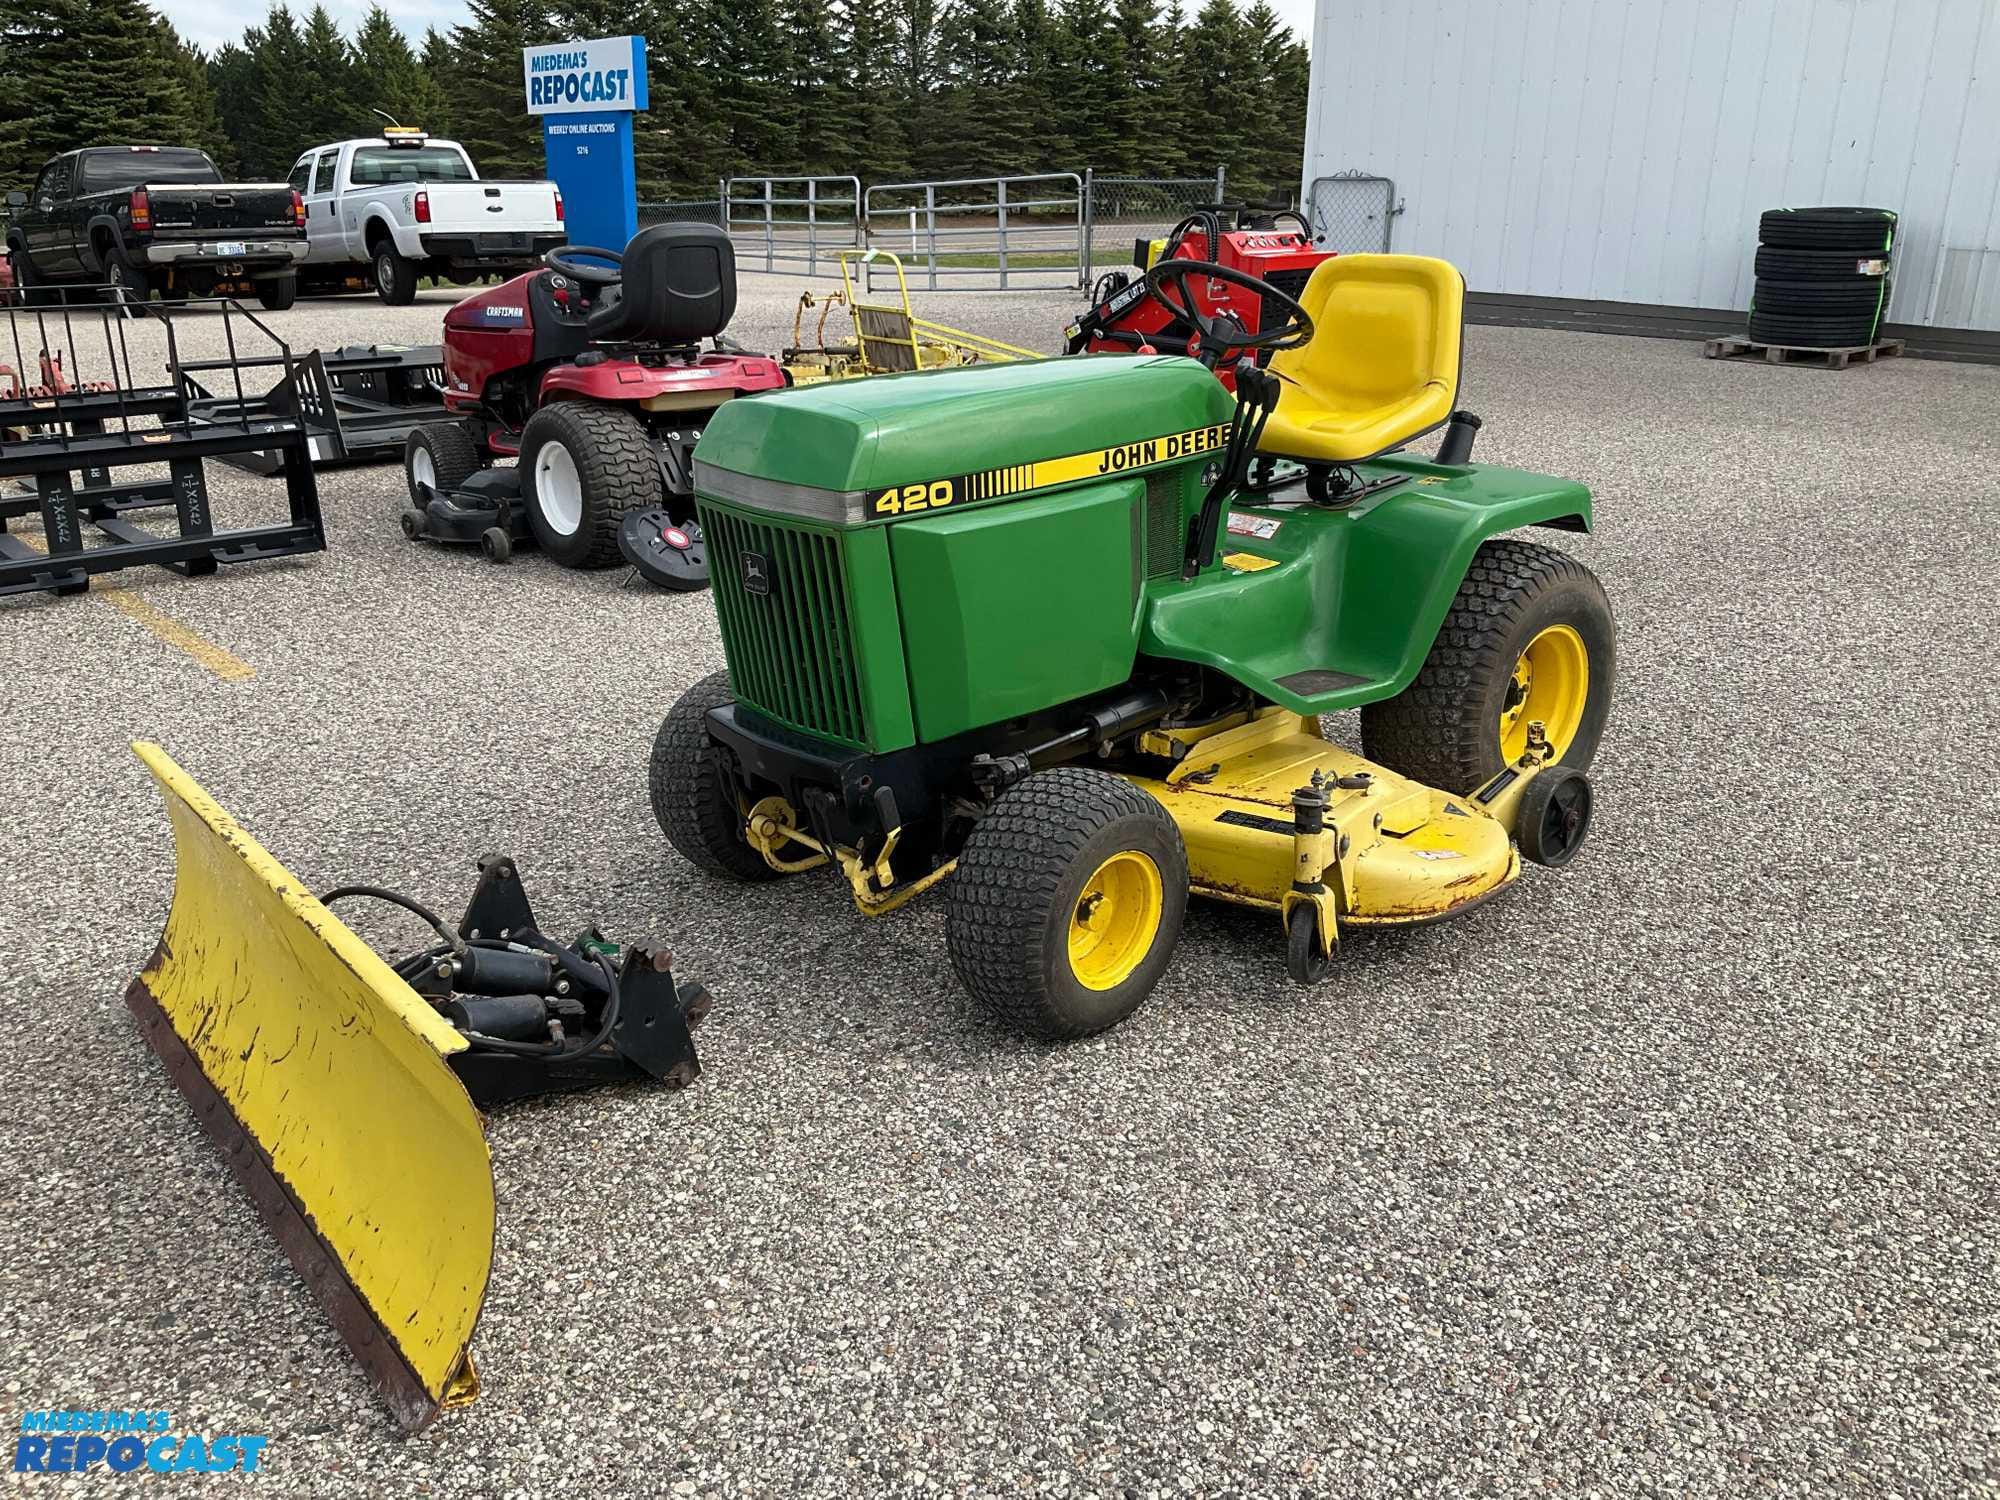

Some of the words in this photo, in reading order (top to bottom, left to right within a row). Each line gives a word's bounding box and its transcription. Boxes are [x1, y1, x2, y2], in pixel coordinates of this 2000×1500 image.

[531, 52, 587, 72] MIEDEMA'S
[531, 70, 628, 105] REPOCAST
[548, 125, 569, 135] WEEKLY
[569, 124, 588, 134] ONLINE
[589, 123, 616, 133] AUCTIONS
[486, 306, 523, 317] CRAFTSMAN
[1098, 440, 1157, 473] JOHN
[1167, 423, 1232, 458] DEERE
[876, 481, 953, 515] 420
